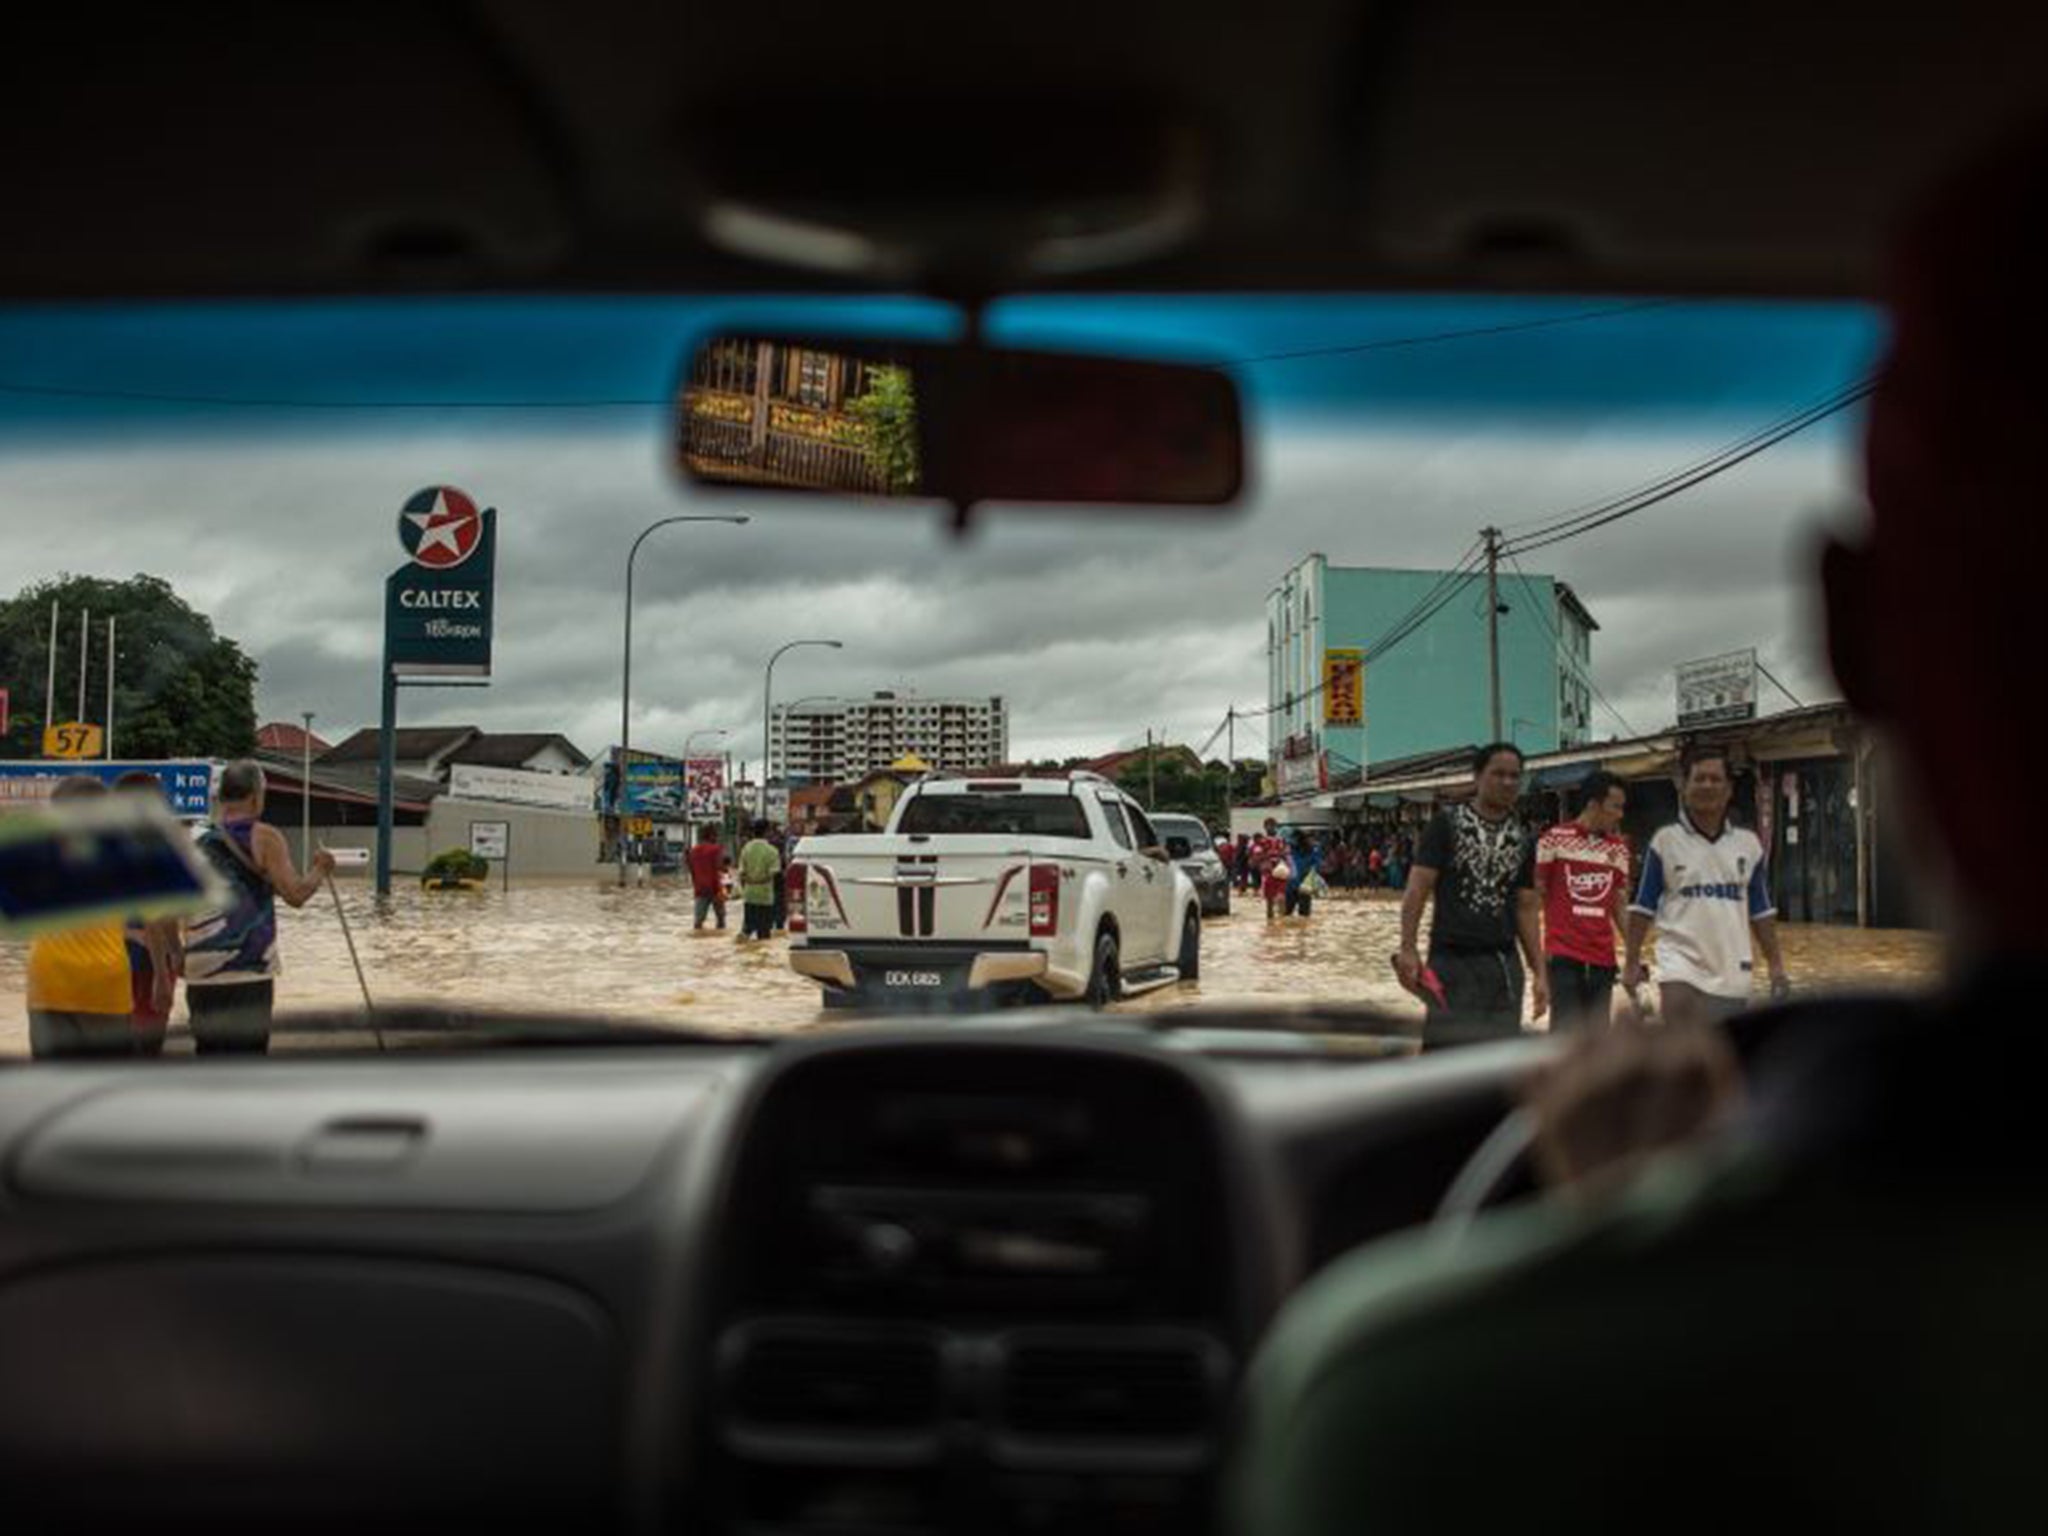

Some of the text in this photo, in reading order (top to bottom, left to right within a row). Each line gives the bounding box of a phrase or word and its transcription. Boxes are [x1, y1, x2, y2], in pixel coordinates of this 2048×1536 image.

[400, 589, 480, 608] CALTEX
[57, 728, 89, 752] 57
[175, 772, 206, 787] km
[174, 792, 205, 806] km
